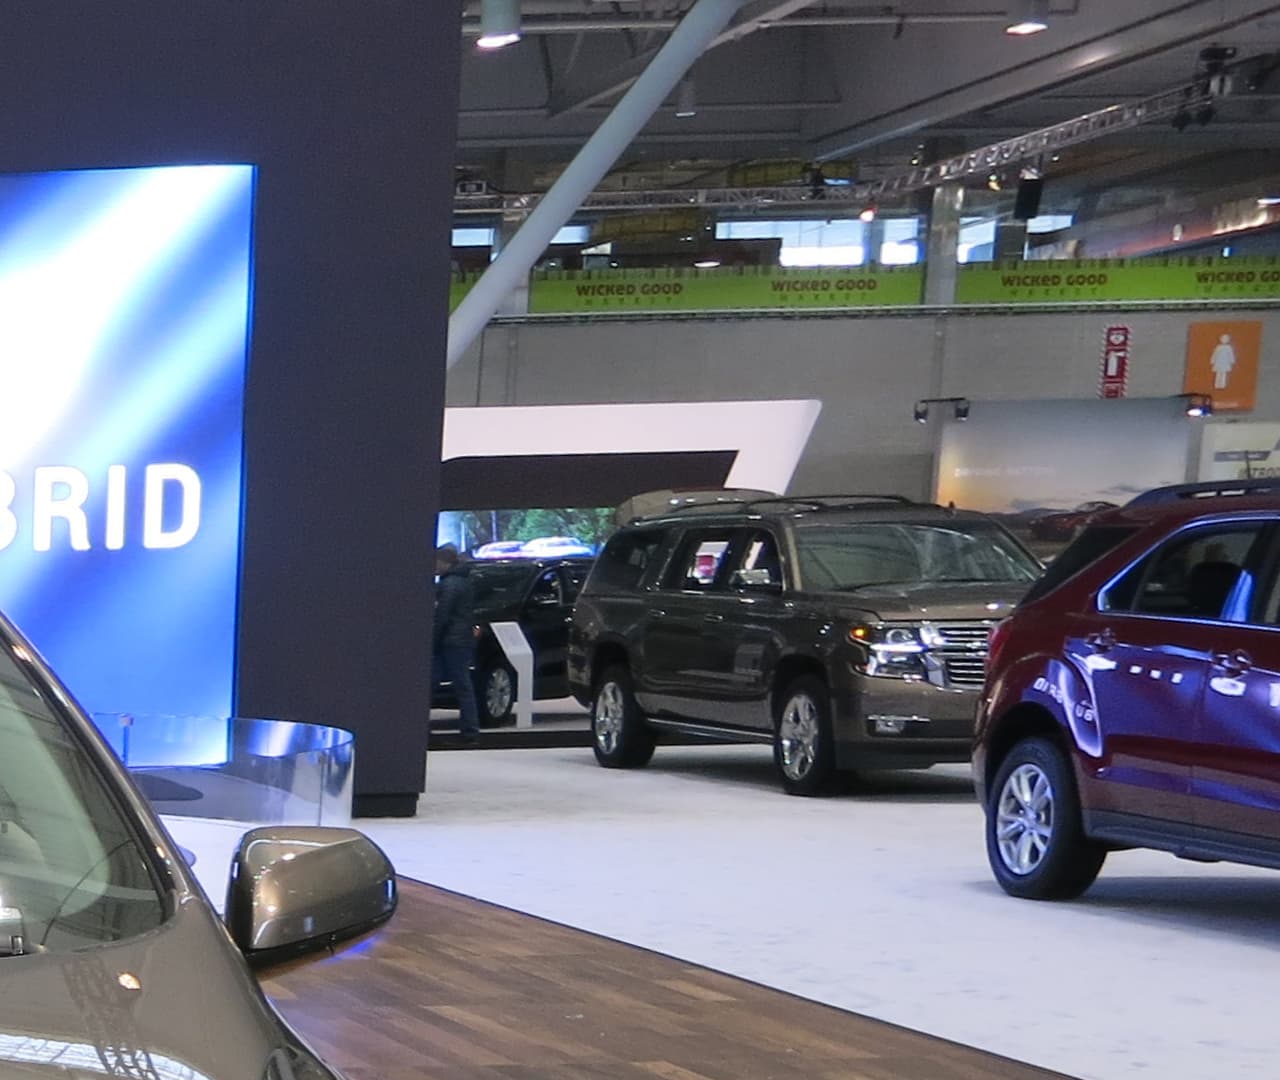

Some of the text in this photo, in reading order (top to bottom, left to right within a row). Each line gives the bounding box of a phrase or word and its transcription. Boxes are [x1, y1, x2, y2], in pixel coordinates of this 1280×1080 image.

[835, 278, 877, 290] GOOD
[1066, 273, 1108, 286] GOOD
[640, 282, 683, 295] GOOD
